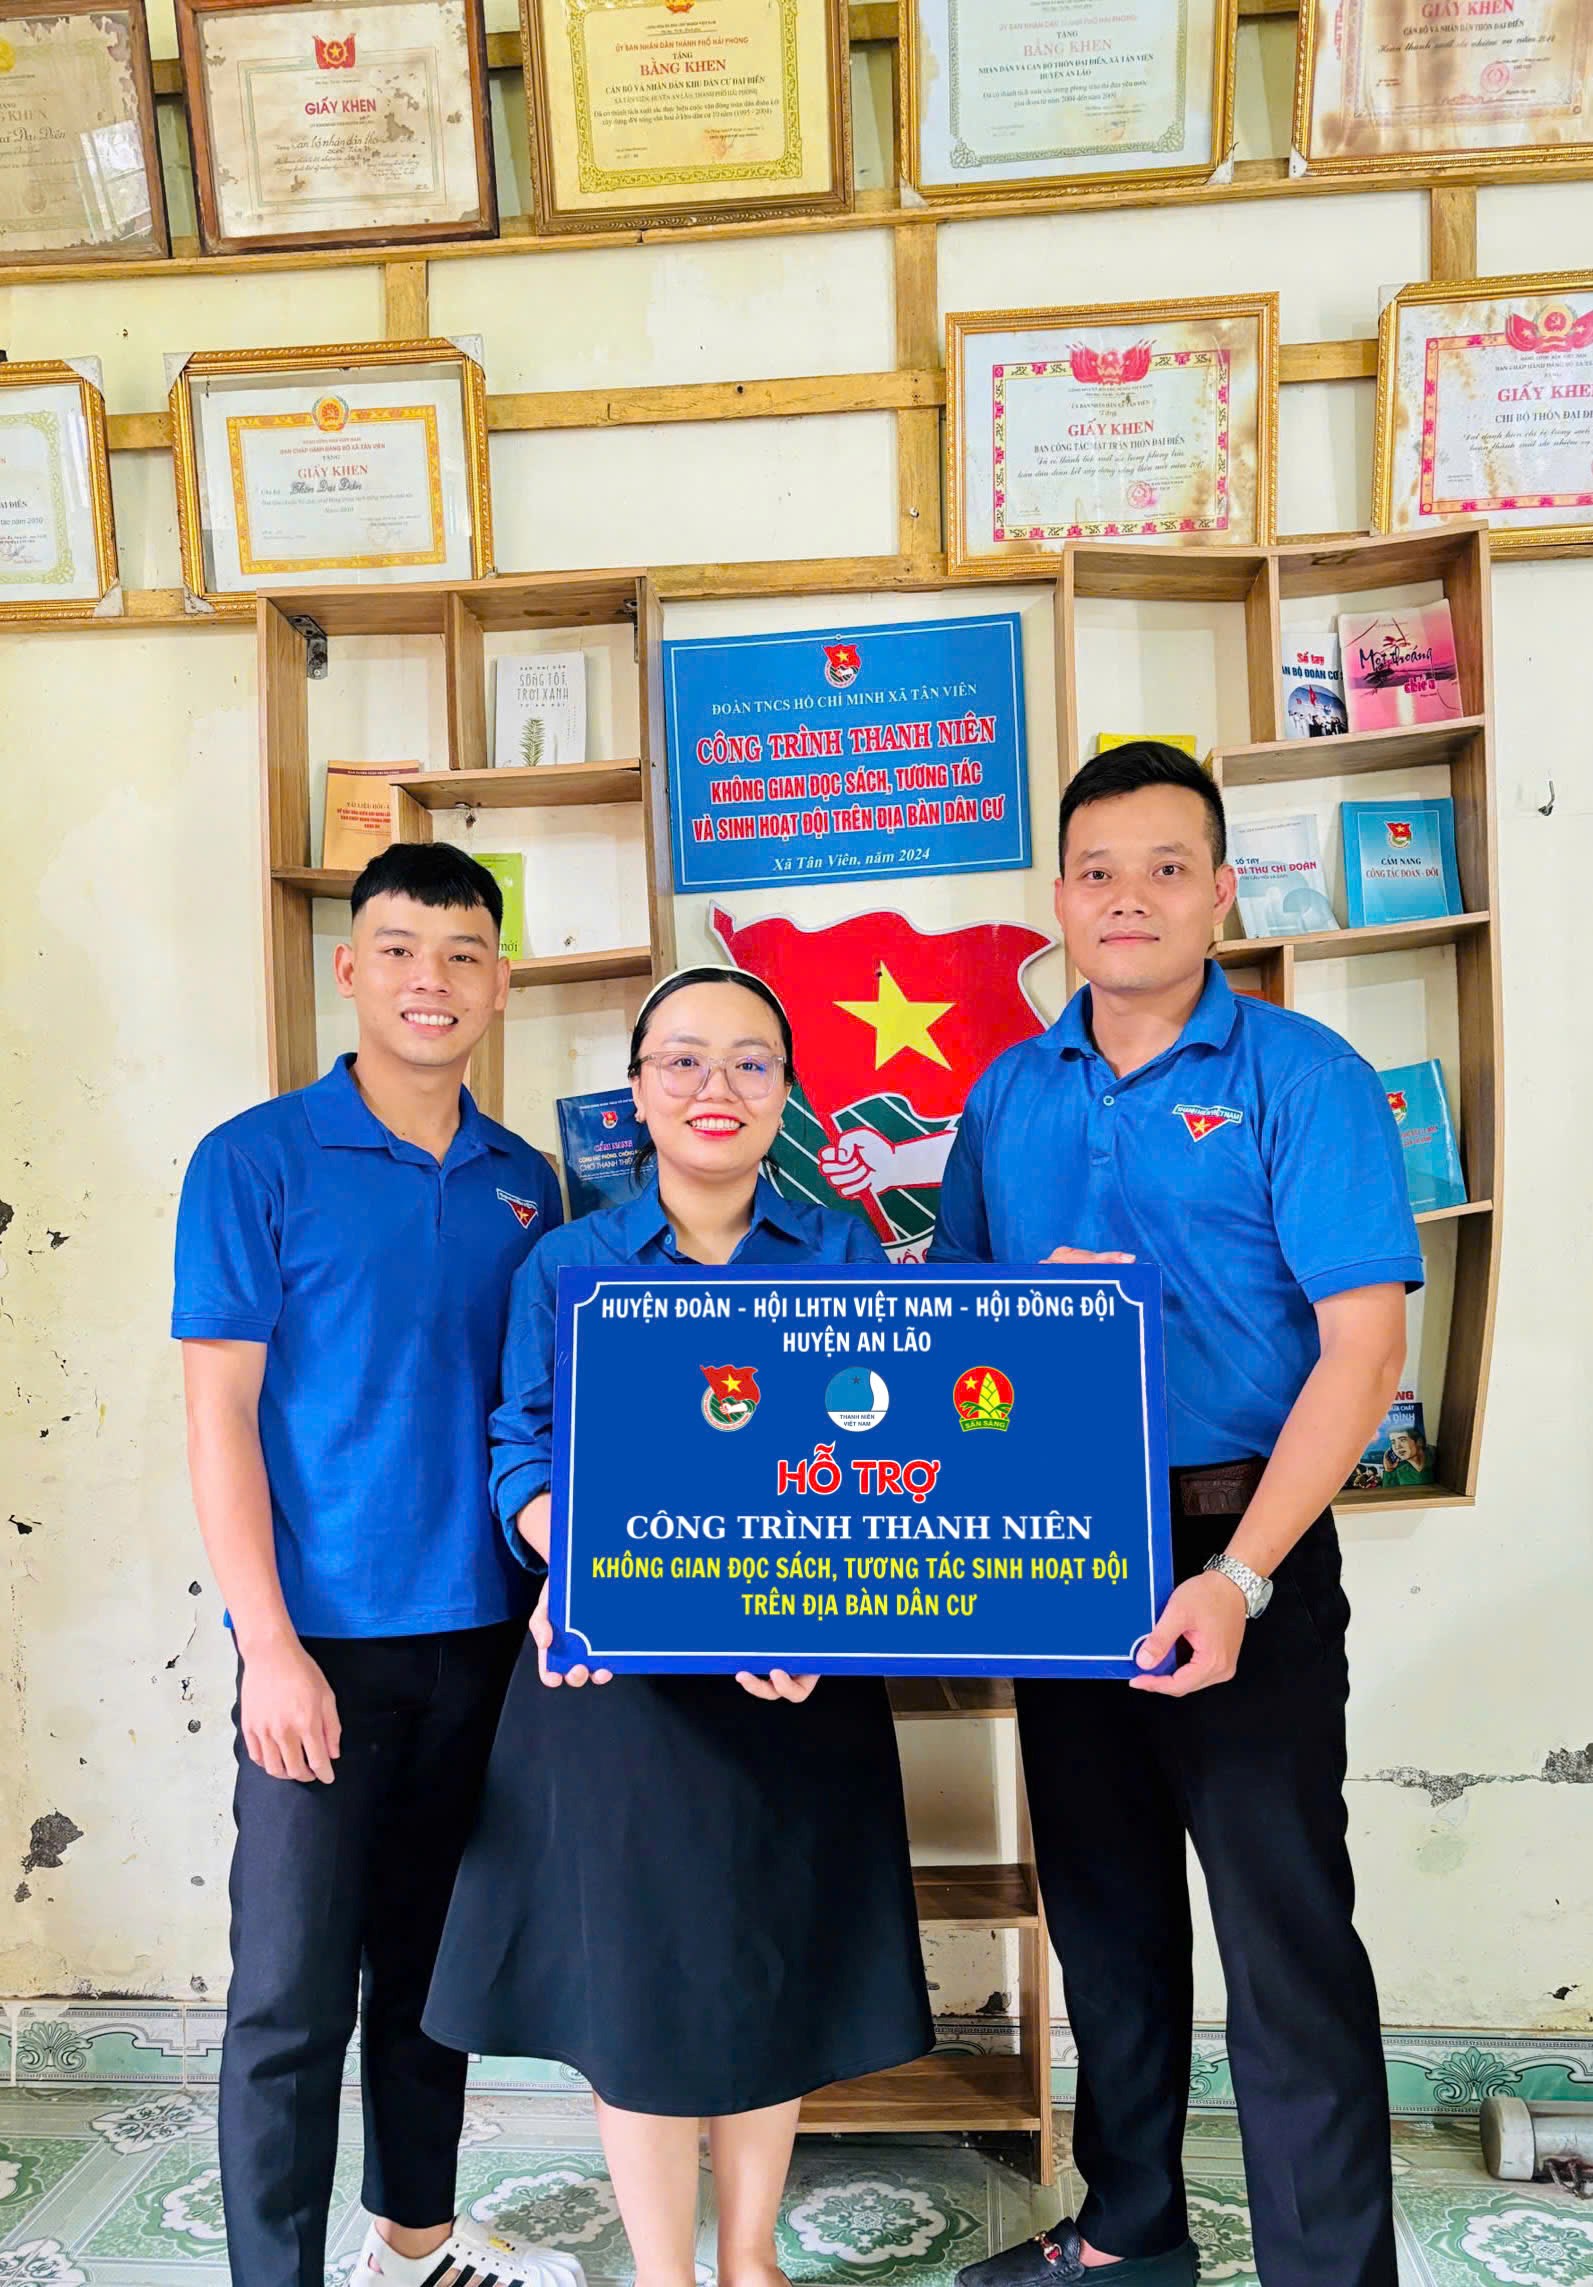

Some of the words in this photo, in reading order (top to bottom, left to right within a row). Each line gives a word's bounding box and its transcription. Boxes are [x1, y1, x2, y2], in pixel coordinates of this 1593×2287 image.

[1070, 39, 1112, 53] KHEN
[640, 57, 680, 76] BẰNG
[685, 59, 727, 73] KHEN
[305, 96, 339, 116] GIẤY
[342, 98, 377, 113] KHEN
[1497, 381, 1545, 402] GIẤY
[1551, 383, 1593, 399] KHE
[1068, 418, 1107, 437] GIẤY
[1111, 420, 1155, 436] KHEN
[332, 464, 369, 477] KHEN
[542, 688, 569, 700] XANH
[712, 702, 751, 716] ĐOÀN
[754, 699, 790, 713] TNCS
[794, 695, 814, 711] HỒ
[818, 693, 844, 709] CHÍ
[847, 691, 885, 707] MINH
[888, 687, 908, 702] XÃ
[911, 683, 940, 701] TÂN
[943, 683, 978, 698] VIÊN
[697, 731, 761, 765] CÔNG
[768, 724, 842, 761] TRÌNH
[849, 723, 931, 755] THANH
[938, 712, 997, 747] NIÊN
[711, 776, 764, 805] KHÔNG
[768, 776, 806, 801] GIAN
[810, 773, 842, 802] ĐỌC
[845, 766, 893, 796] SÁCH,
[896, 762, 948, 793] TƯƠNG
[951, 758, 983, 787] TÁC
[693, 814, 715, 843] VÀ
[717, 815, 755, 841] SINH
[759, 812, 799, 843] HOẠT
[802, 806, 829, 839] ĐỘI
[833, 804, 873, 834] TRÊN
[877, 804, 905, 834] ĐỊA
[908, 797, 942, 827] BÀN
[945, 794, 979, 823] DÂN
[981, 793, 1006, 821] CƯ
[773, 858, 793, 872] Xã
[797, 856, 823, 870] Tân
[866, 851, 895, 864] năm
[899, 848, 931, 862] 2024
[1271, 863, 1287, 873] CHI
[1289, 861, 1317, 872] ĐOÀN
[1399, 857, 1422, 865] NANG
[597, 1161, 618, 1169] THANH
[601, 1291, 669, 1322] HUYỆN
[674, 1291, 732, 1319] ĐOÀN
[753, 1291, 788, 1321] HỘI
[795, 1297, 846, 1319] LHTN
[854, 1292, 896, 1320] VIỆT
[905, 1296, 950, 1318] NAM
[976, 1291, 1010, 1320] HỘI
[1017, 1288, 1073, 1318] ĐỒNG
[1080, 1289, 1115, 1319] ĐỘI
[782, 1327, 850, 1357] HUYỆN
[857, 1332, 886, 1353] AN
[893, 1327, 932, 1353] LÃO
[843, 1420, 856, 1428] VIỆT
[861, 1412, 875, 1420] NIÊN
[777, 1441, 843, 1496] HỖ
[851, 1459, 941, 1503] TRỢ
[626, 1510, 726, 1541] CÔNG
[737, 1511, 851, 1540] TRÌNH
[862, 1515, 991, 1540] THANH
[1002, 1510, 1092, 1540] NIÊN
[592, 1551, 664, 1580] KHÔNG
[670, 1557, 721, 1579] GIAN
[727, 1557, 769, 1584] ĐỌC
[775, 1551, 838, 1583] SÁCH,
[844, 1556, 919, 1580] TƯƠNG
[927, 1551, 966, 1580] TÁC
[971, 1557, 1023, 1580] SINH
[1031, 1557, 1085, 1585] HOẠT
[1091, 1551, 1128, 1585] ĐỘI
[741, 1588, 796, 1616] TRÊN
[802, 1594, 839, 1621] ĐỊA
[845, 1587, 888, 1616] BÀN
[896, 1588, 939, 1616] DÂN
[946, 1592, 977, 1616] CƯ
